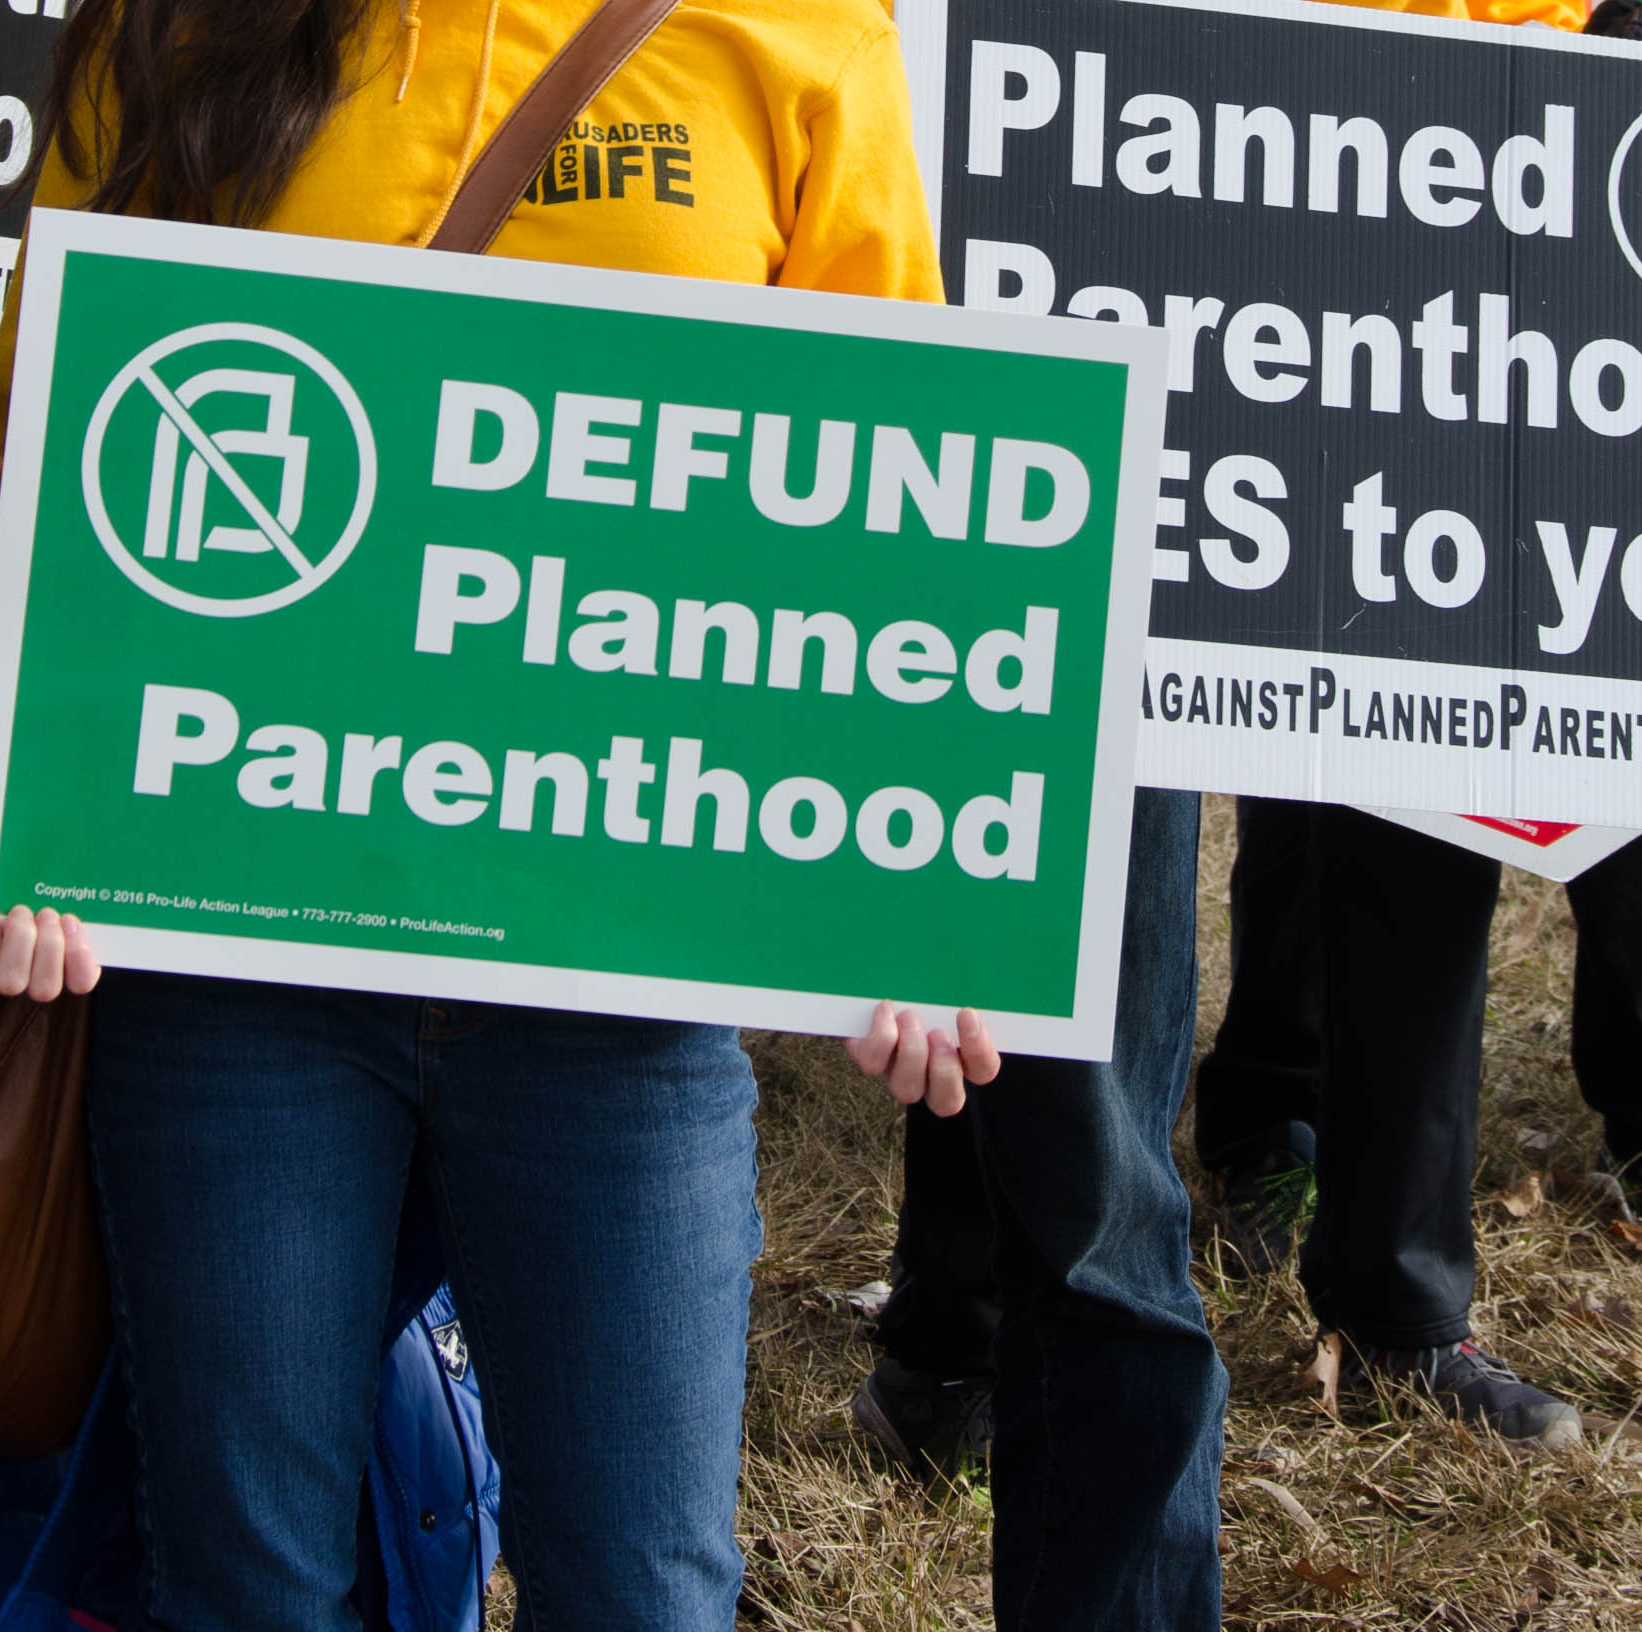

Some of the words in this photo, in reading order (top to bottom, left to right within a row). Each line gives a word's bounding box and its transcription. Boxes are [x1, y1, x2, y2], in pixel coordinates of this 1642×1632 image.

[541, 144, 694, 208] LIFE
[560, 144, 578, 185] FOR
[967, 38, 1575, 239] Planned
[431, 378, 1091, 550] DEFUND
[1343, 471, 1486, 609] to
[414, 543, 1061, 717] Planned
[131, 682, 1046, 883] Parenthood
[34, 882, 96, 900] Copyright
[113, 891, 144, 904] 2016
[146, 893, 197, 909] Pro-Life
[199, 898, 240, 913] Action
[242, 902, 289, 919] League
[302, 908, 387, 928] 773-777-2900
